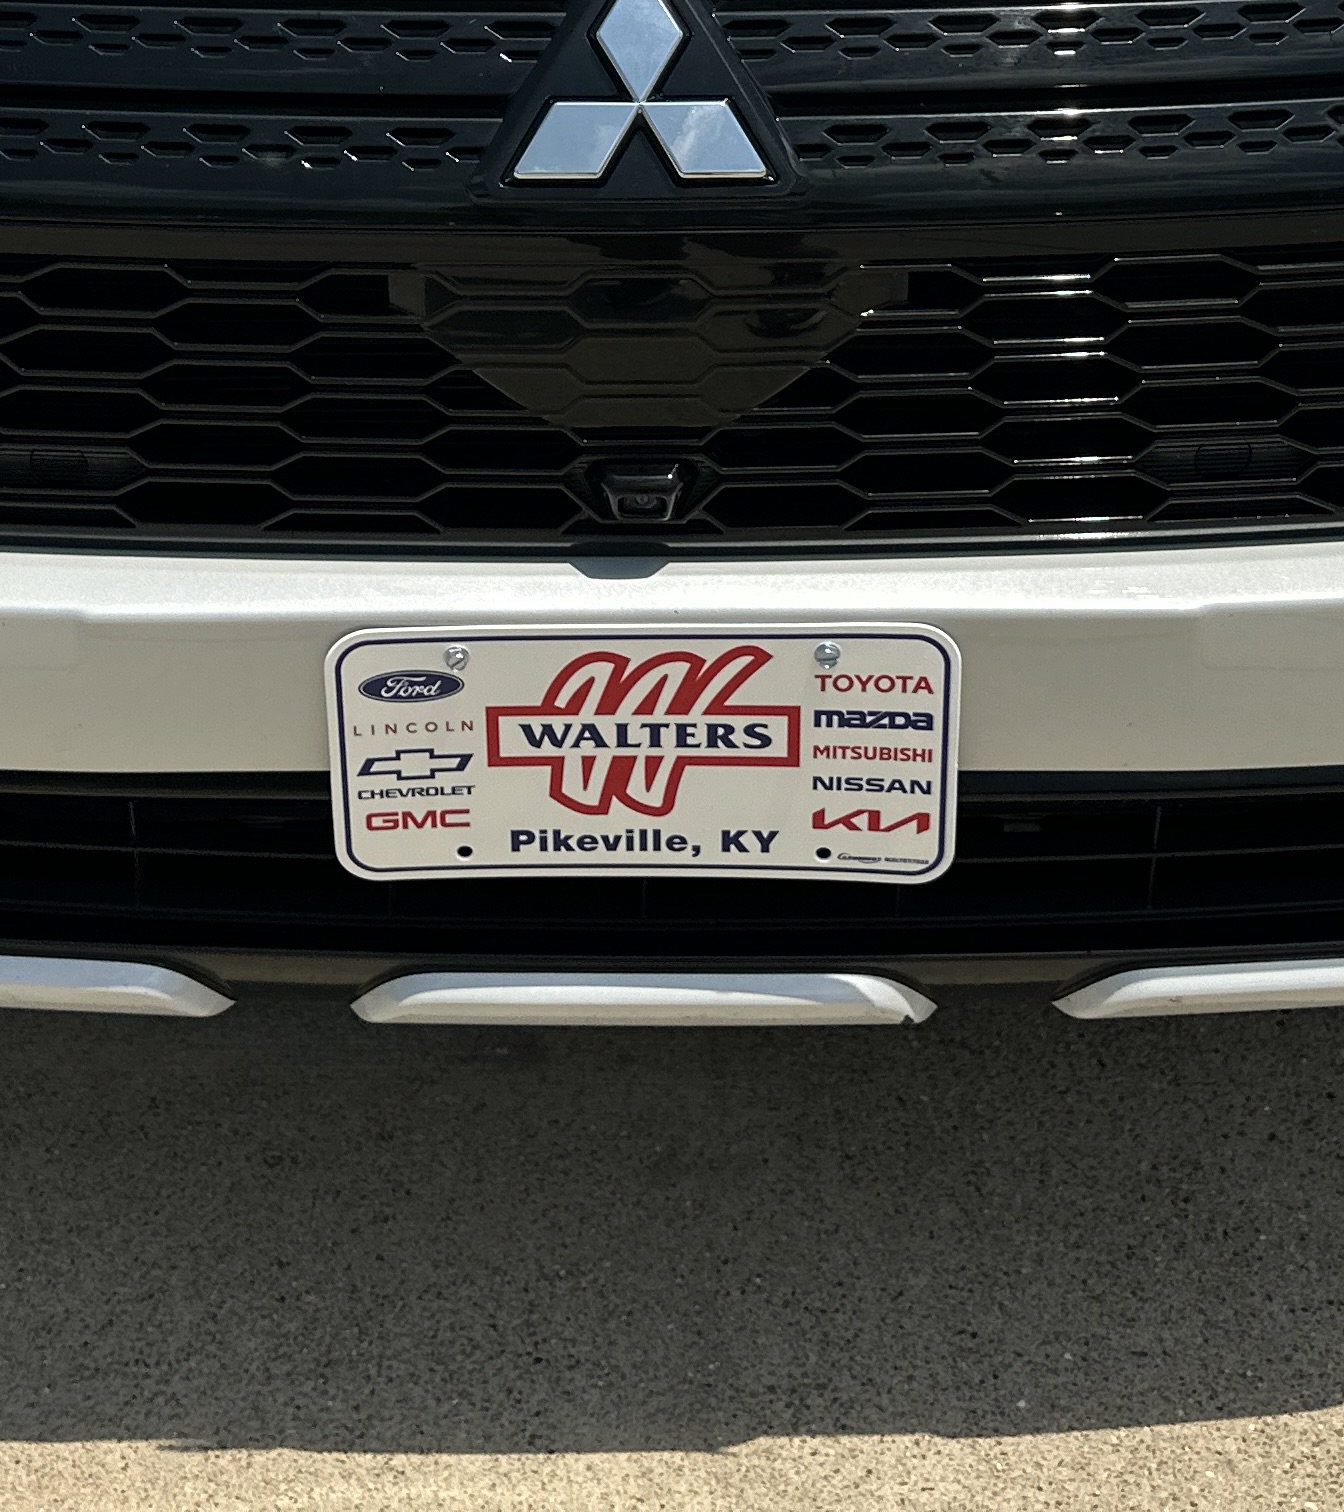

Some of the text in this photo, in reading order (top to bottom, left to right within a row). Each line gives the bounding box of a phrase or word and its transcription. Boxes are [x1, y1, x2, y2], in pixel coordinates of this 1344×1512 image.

[380, 675, 442, 698] Ford
[814, 673, 935, 695] TOYOTA
[353, 719, 474, 737] LINCOLN
[517, 722, 774, 750] WALTERS
[812, 744, 934, 764] MITSUBISHI
[357, 784, 477, 801] CHEVROLET
[812, 775, 933, 796] NISSAN
[365, 808, 472, 832] GMC
[509, 828, 781, 859] Pikeville, KY
